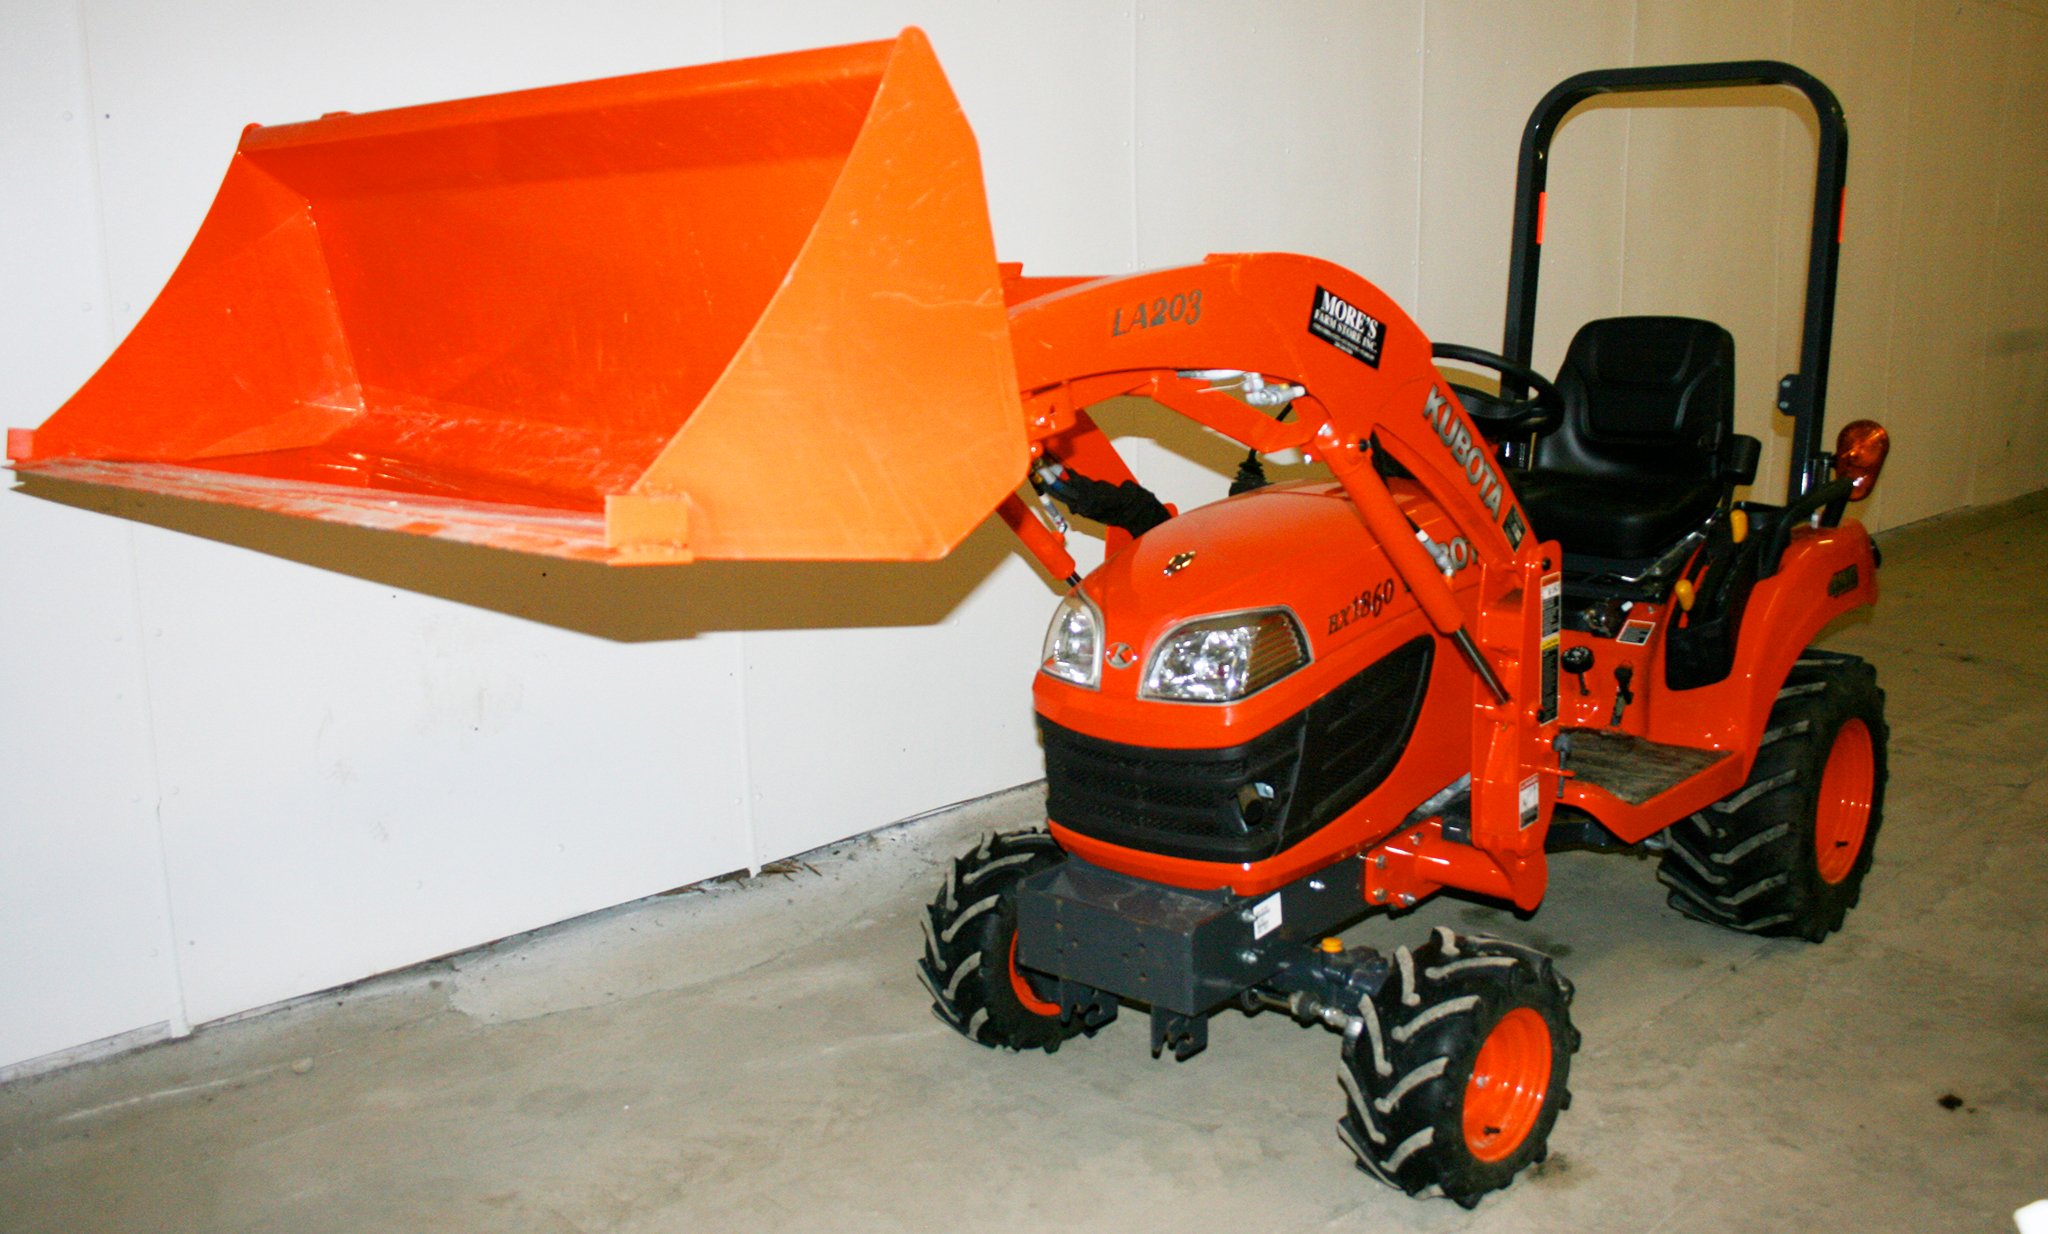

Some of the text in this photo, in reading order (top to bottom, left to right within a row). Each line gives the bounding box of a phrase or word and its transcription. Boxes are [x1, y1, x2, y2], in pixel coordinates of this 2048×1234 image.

[1112, 288, 1203, 338] LA203
[1313, 308, 1337, 331] FARM
[1338, 322, 1362, 345] STORE
[1321, 290, 1379, 340] MORE'S
[1423, 384, 1503, 523] KUBOTA
[1327, 578, 1395, 635] BX1860
